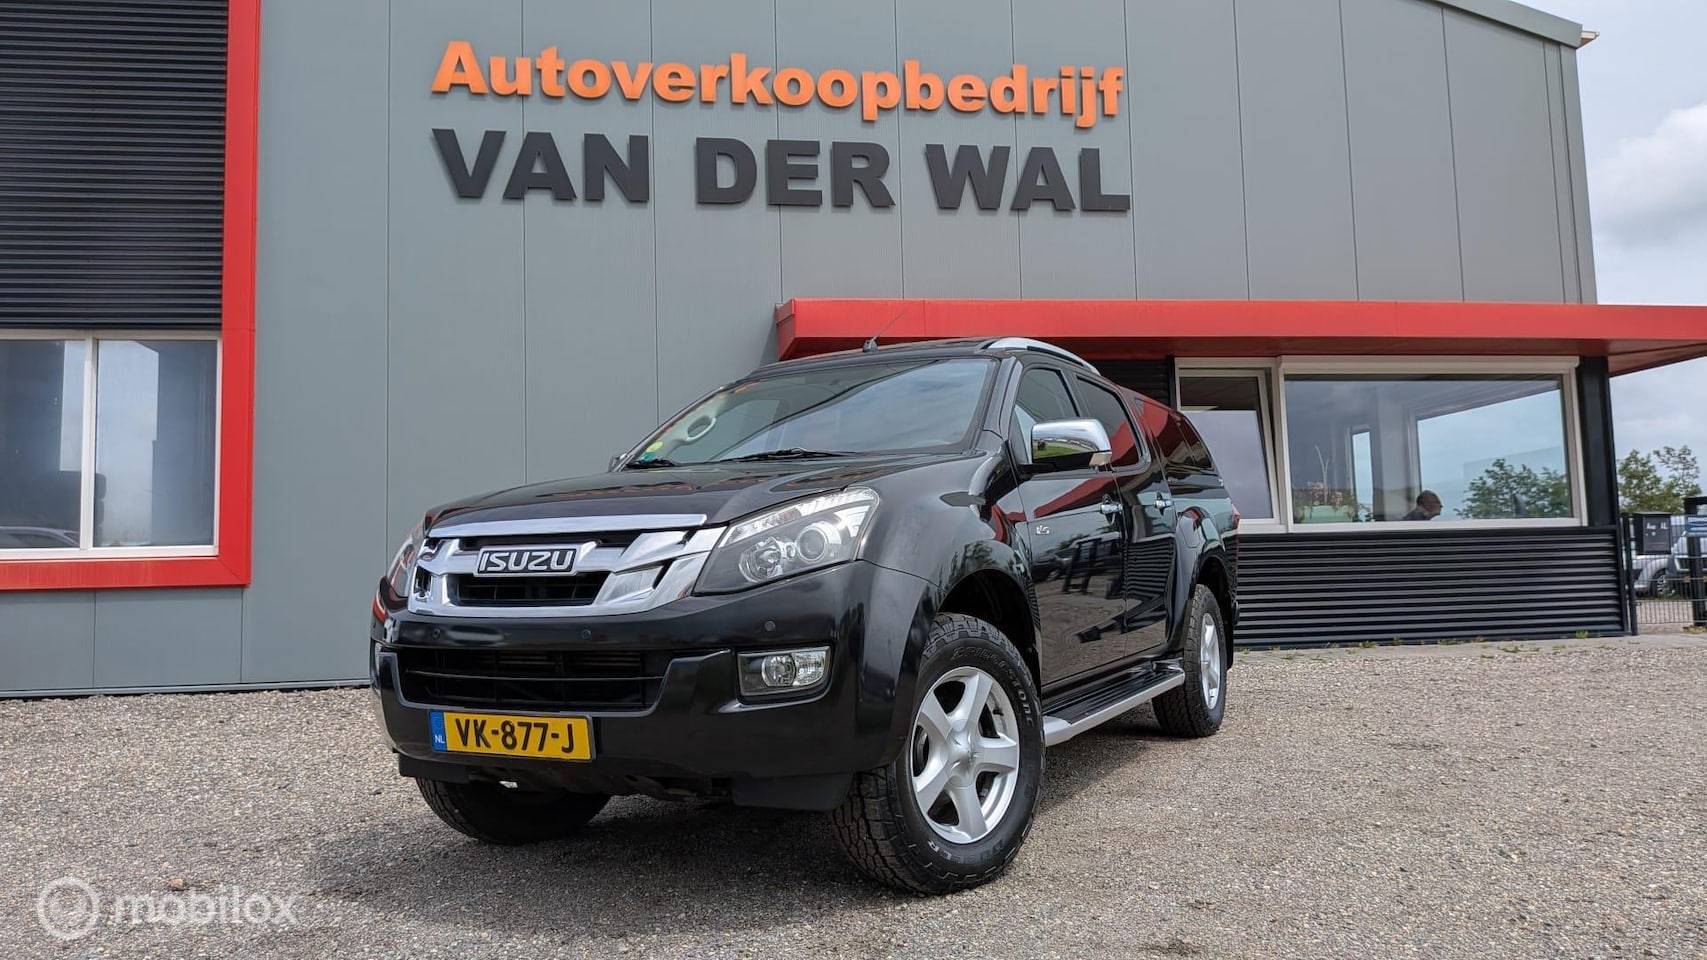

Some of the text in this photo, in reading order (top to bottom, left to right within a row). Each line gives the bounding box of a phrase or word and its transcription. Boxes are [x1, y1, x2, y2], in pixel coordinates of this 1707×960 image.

[431, 41, 1124, 128] Autoverkoopbedrijf
[432, 129, 1131, 212] VAN DER WAL
[480, 550, 574, 572] ISUZU
[435, 734, 446, 744] NL
[455, 718, 575, 753] VK-877-J
